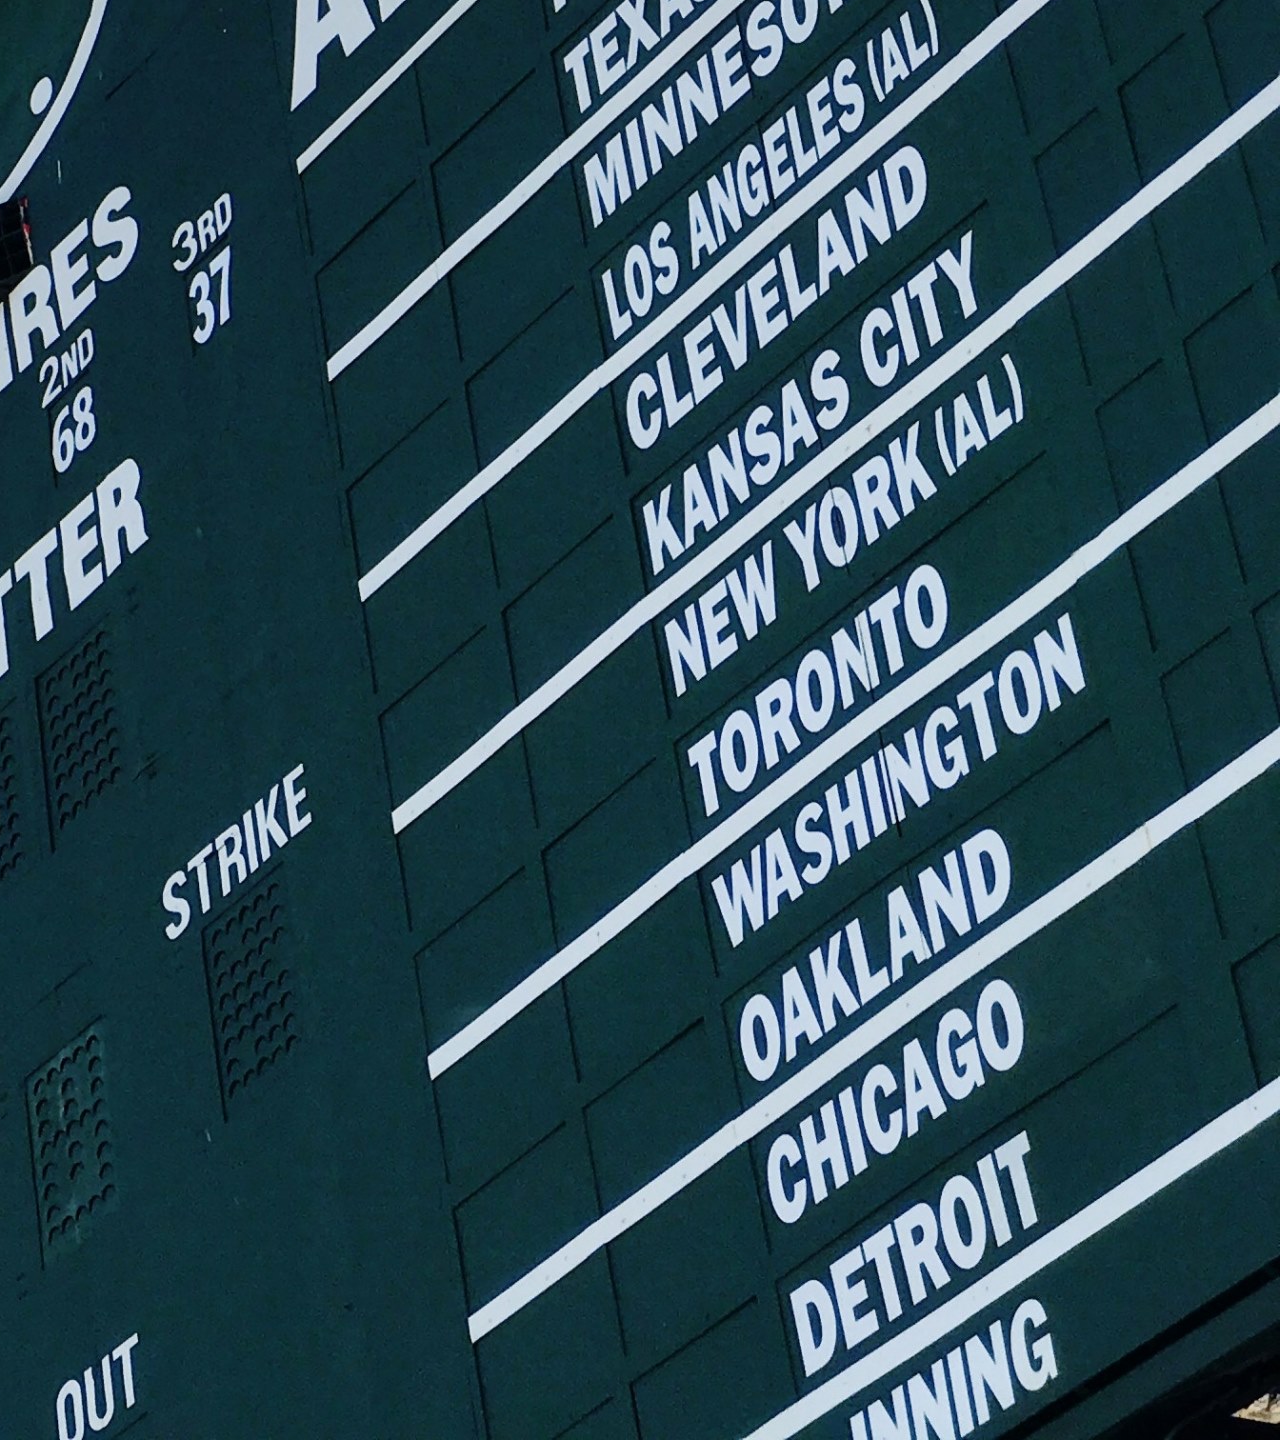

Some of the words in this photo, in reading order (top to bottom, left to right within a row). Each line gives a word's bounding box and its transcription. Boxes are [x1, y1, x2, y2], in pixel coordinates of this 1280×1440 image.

[172, 194, 231, 271] 3RD
[189, 246, 230, 343] 37
[602, 222, 678, 340] LOS
[689, 59, 864, 269] ANGELES
[627, 146, 926, 448] CLEVELAND
[40, 329, 93, 408] 2ND
[53, 387, 95, 472] 68
[643, 350, 849, 575] KANSAS
[861, 231, 977, 386] CITY
[665, 540, 776, 697] NEW
[783, 421, 937, 592] YORK
[935, 354, 1023, 476] (AL)
[688, 565, 947, 816] TORONTO
[712, 613, 1085, 947] WASHINGTON
[163, 764, 311, 939] STRIKE
[740, 830, 1010, 1081] OAKLAND
[768, 980, 1023, 1223] CHICAGO
[790, 1131, 1037, 1377] DETROIT
[57, 1333, 138, 1440] OUT
